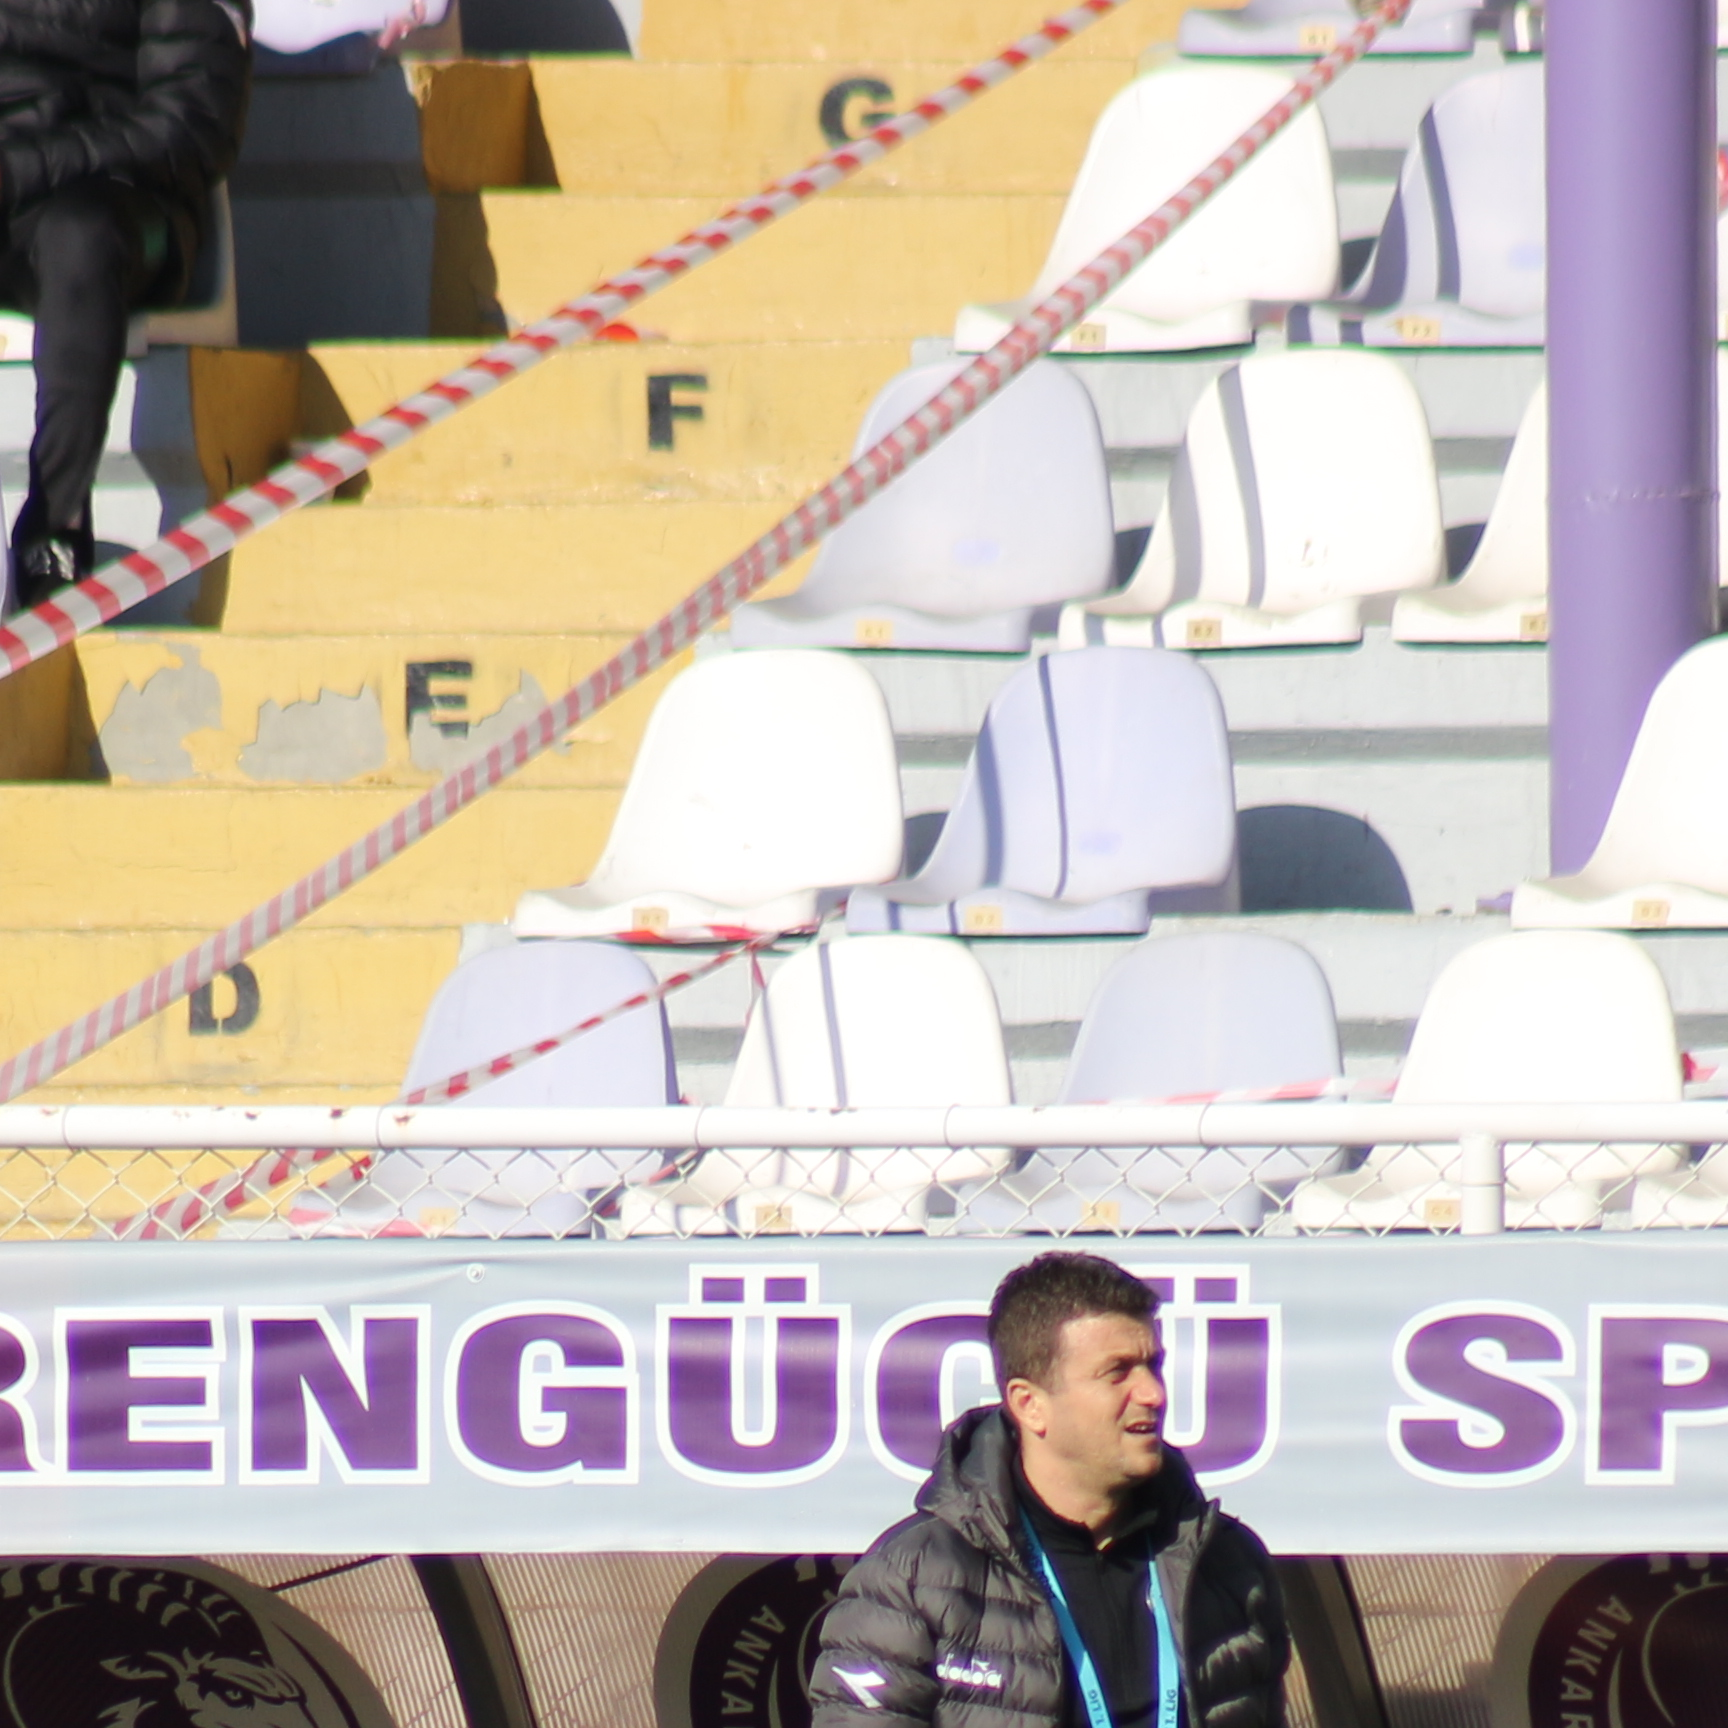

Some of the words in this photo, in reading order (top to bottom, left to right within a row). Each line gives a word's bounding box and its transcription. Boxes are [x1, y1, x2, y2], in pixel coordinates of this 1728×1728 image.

[818, 78, 897, 148] G
[647, 373, 710, 450] F
[405, 660, 474, 738] E
[188, 962, 262, 1036] D
